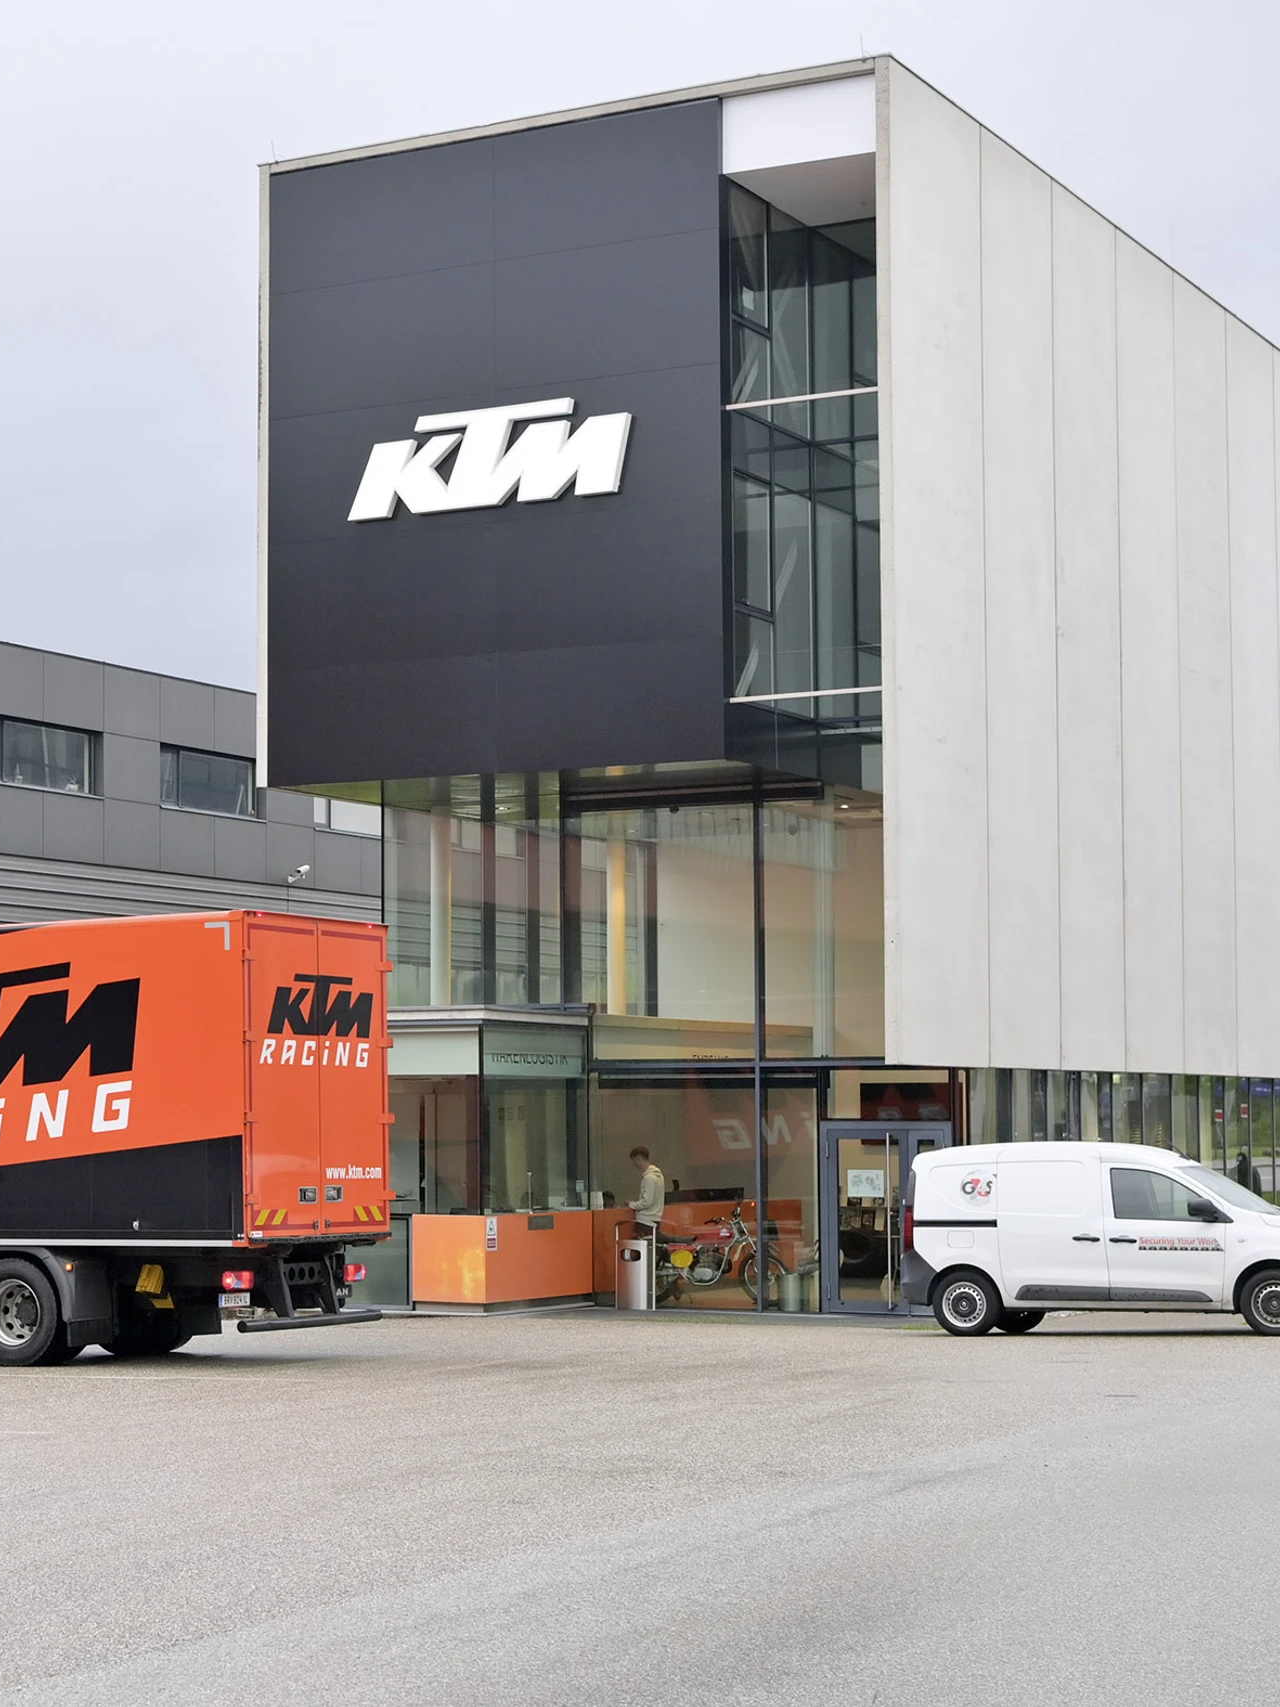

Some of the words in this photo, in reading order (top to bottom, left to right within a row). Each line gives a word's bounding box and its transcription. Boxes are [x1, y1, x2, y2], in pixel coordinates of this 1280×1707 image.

[347, 397, 632, 523] KTM
[267, 973, 374, 1039] KTM
[325, 1165, 382, 1180] www.ktm.com
[1139, 1237, 1175, 1247] Securing
[1177, 1237, 1195, 1246] Your
